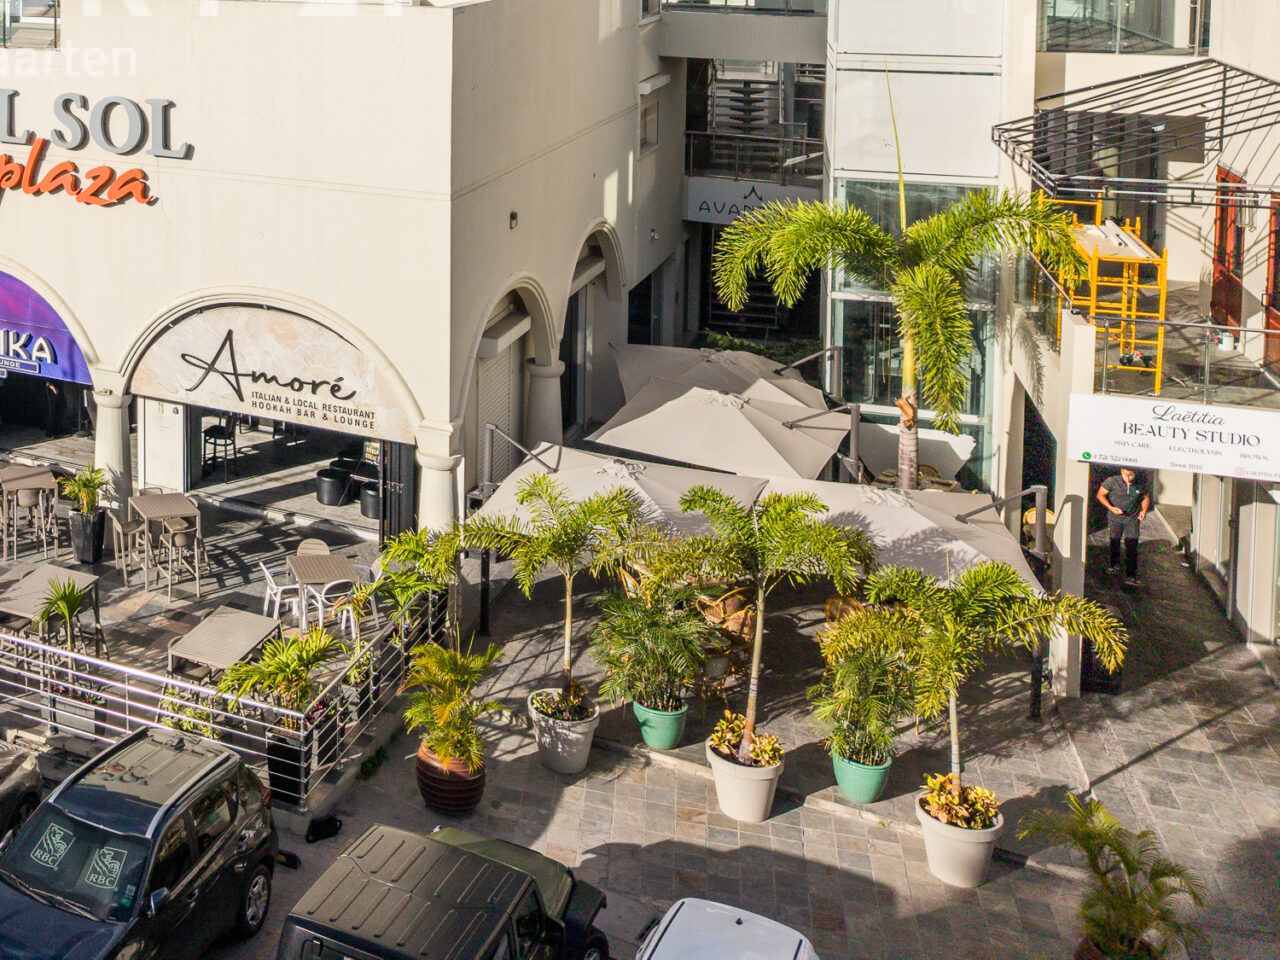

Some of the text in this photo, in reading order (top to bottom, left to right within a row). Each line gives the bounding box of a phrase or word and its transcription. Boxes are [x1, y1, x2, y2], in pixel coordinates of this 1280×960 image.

[51, 92, 195, 160] SOL
[180, 329, 357, 402] Amoré
[251, 391, 375, 420] ITALIAN & LOCAL RESTAURANT
[251, 401, 292, 415] HOOKAH
[297, 408, 316, 419] BAR
[334, 416, 375, 430] LOUNGE
[1122, 422, 1261, 448] BEAUTY STUDIO
[33, 849, 58, 866] RBC
[88, 873, 114, 887] RBC
